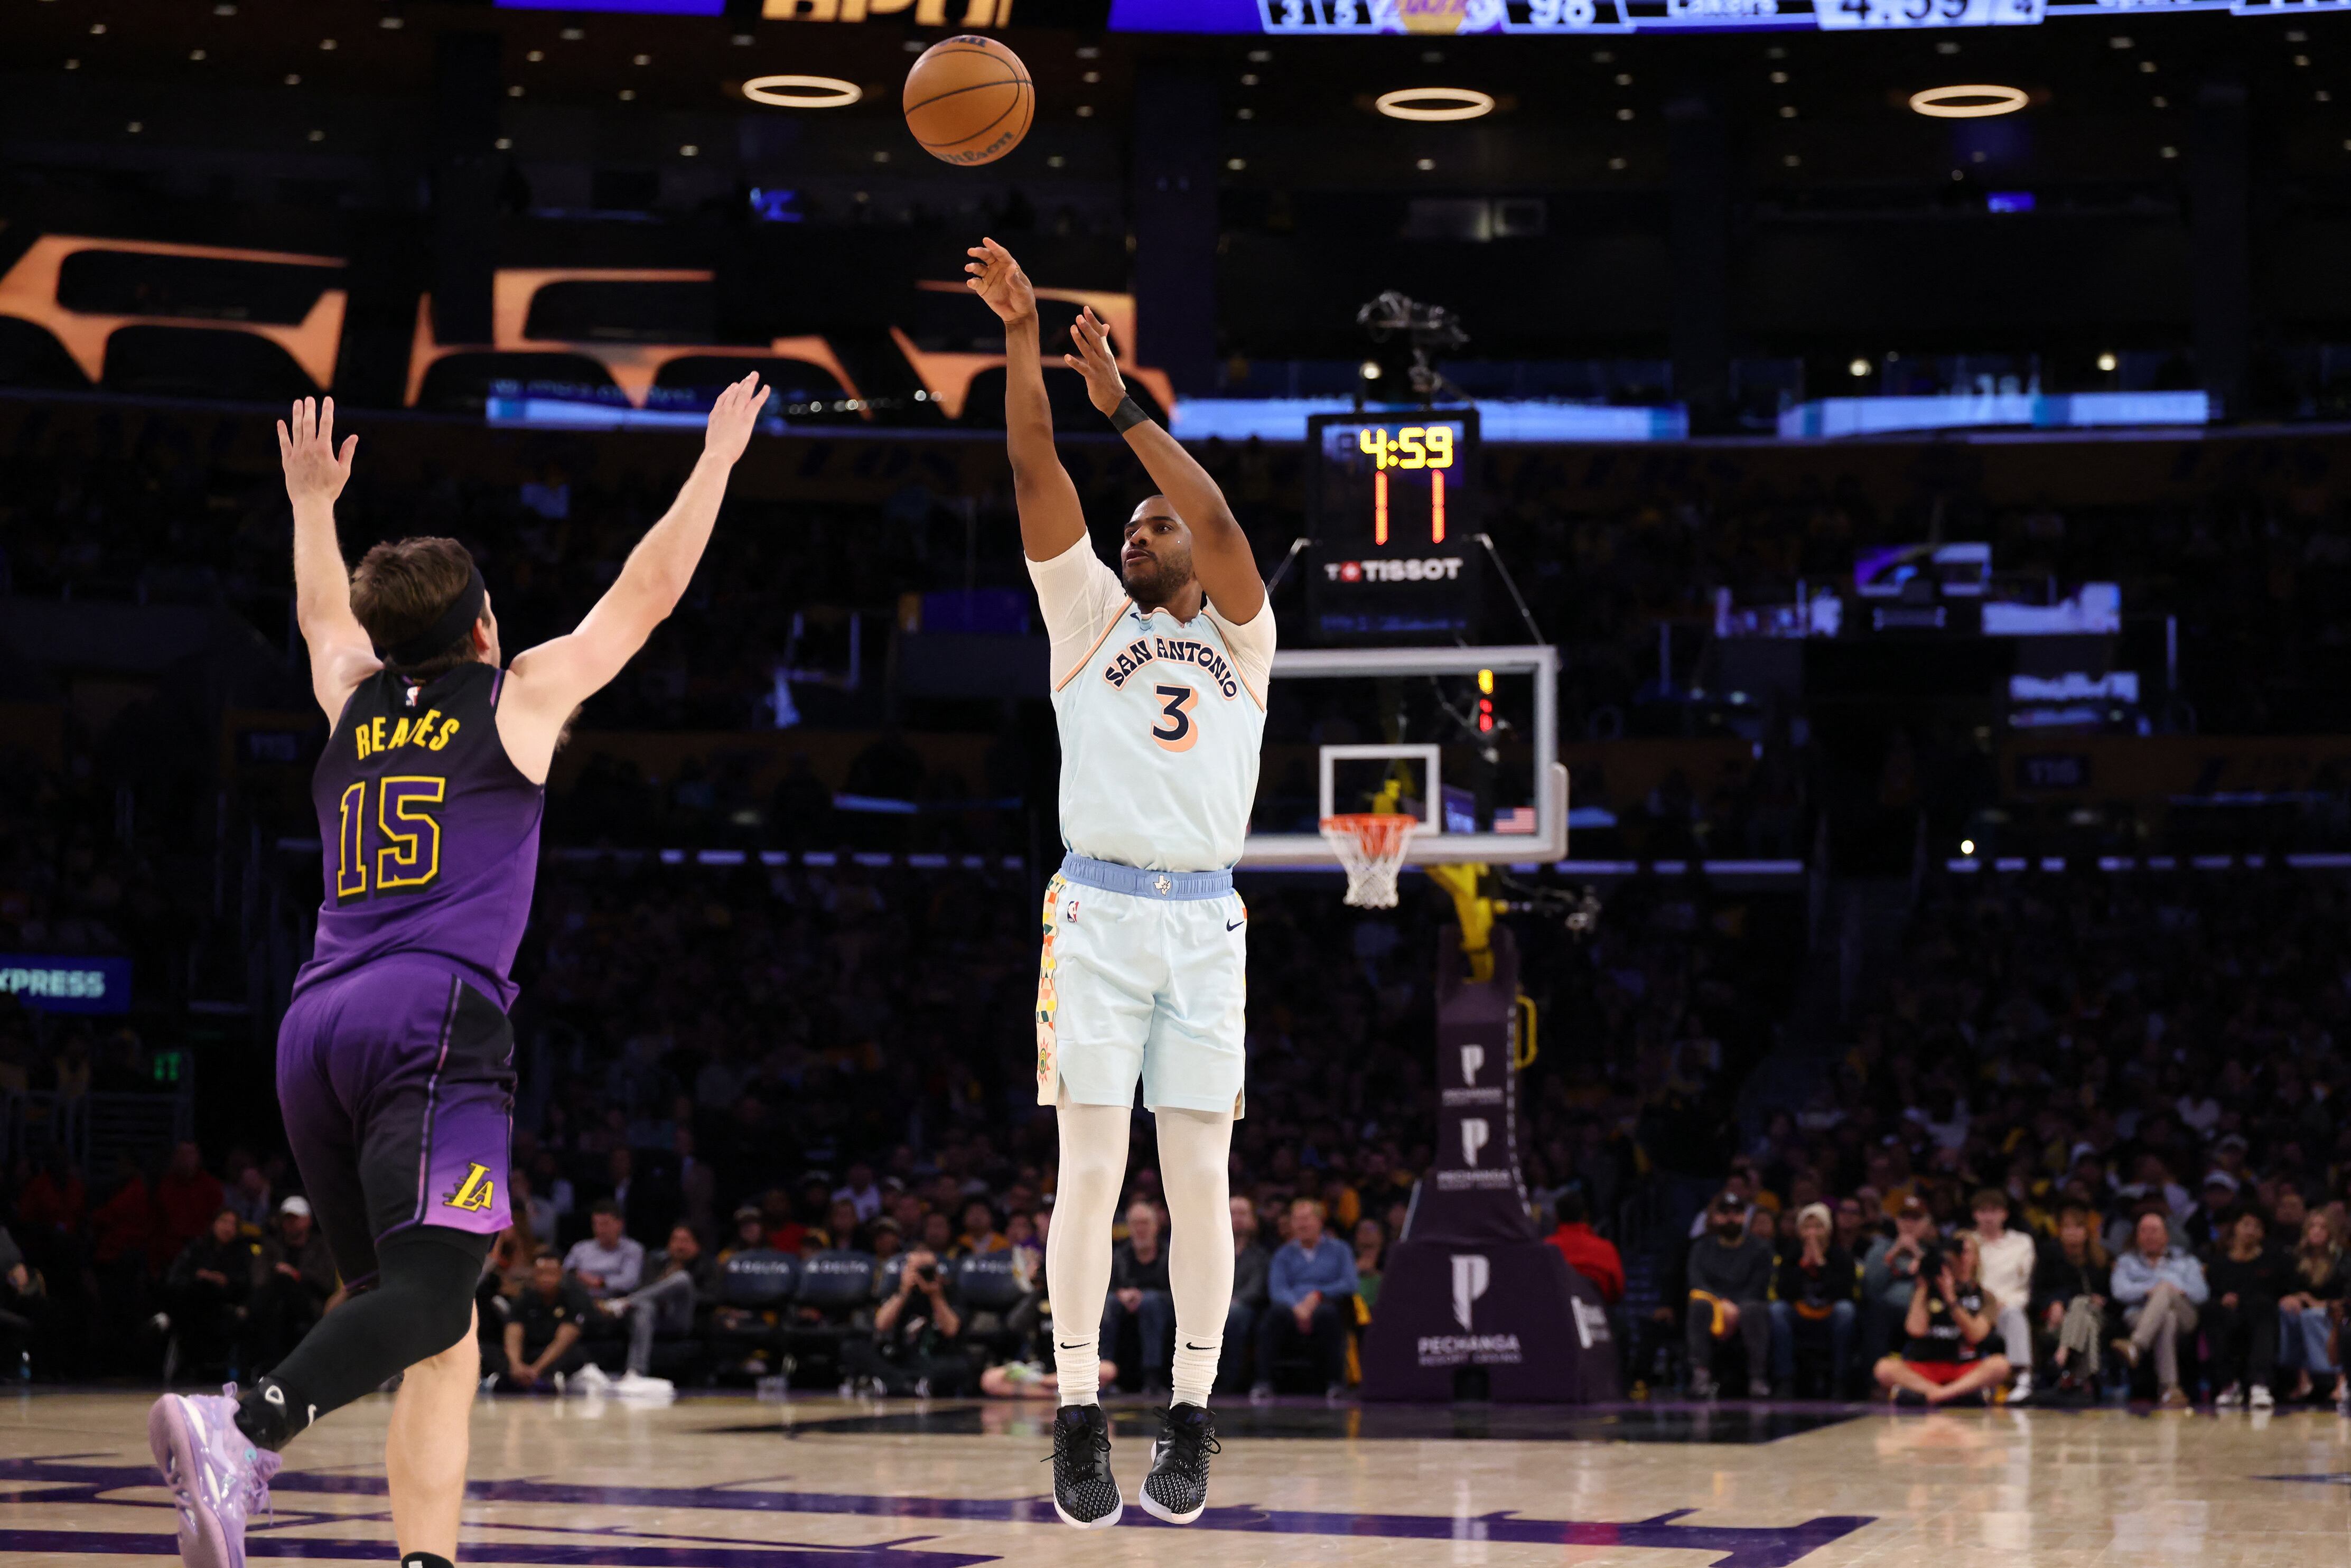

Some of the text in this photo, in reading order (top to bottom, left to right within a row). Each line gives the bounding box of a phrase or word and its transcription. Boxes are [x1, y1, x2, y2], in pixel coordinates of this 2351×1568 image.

[1359, 426, 1453, 470] 4:59
[1375, 469, 1445, 546] 11
[1360, 557, 1463, 582] TISSOT
[1104, 637, 1238, 698] SAN ANTONIO
[1152, 684, 1195, 745] 3
[337, 775, 446, 898] 15
[1417, 1333, 1522, 1355] PECHANGA
